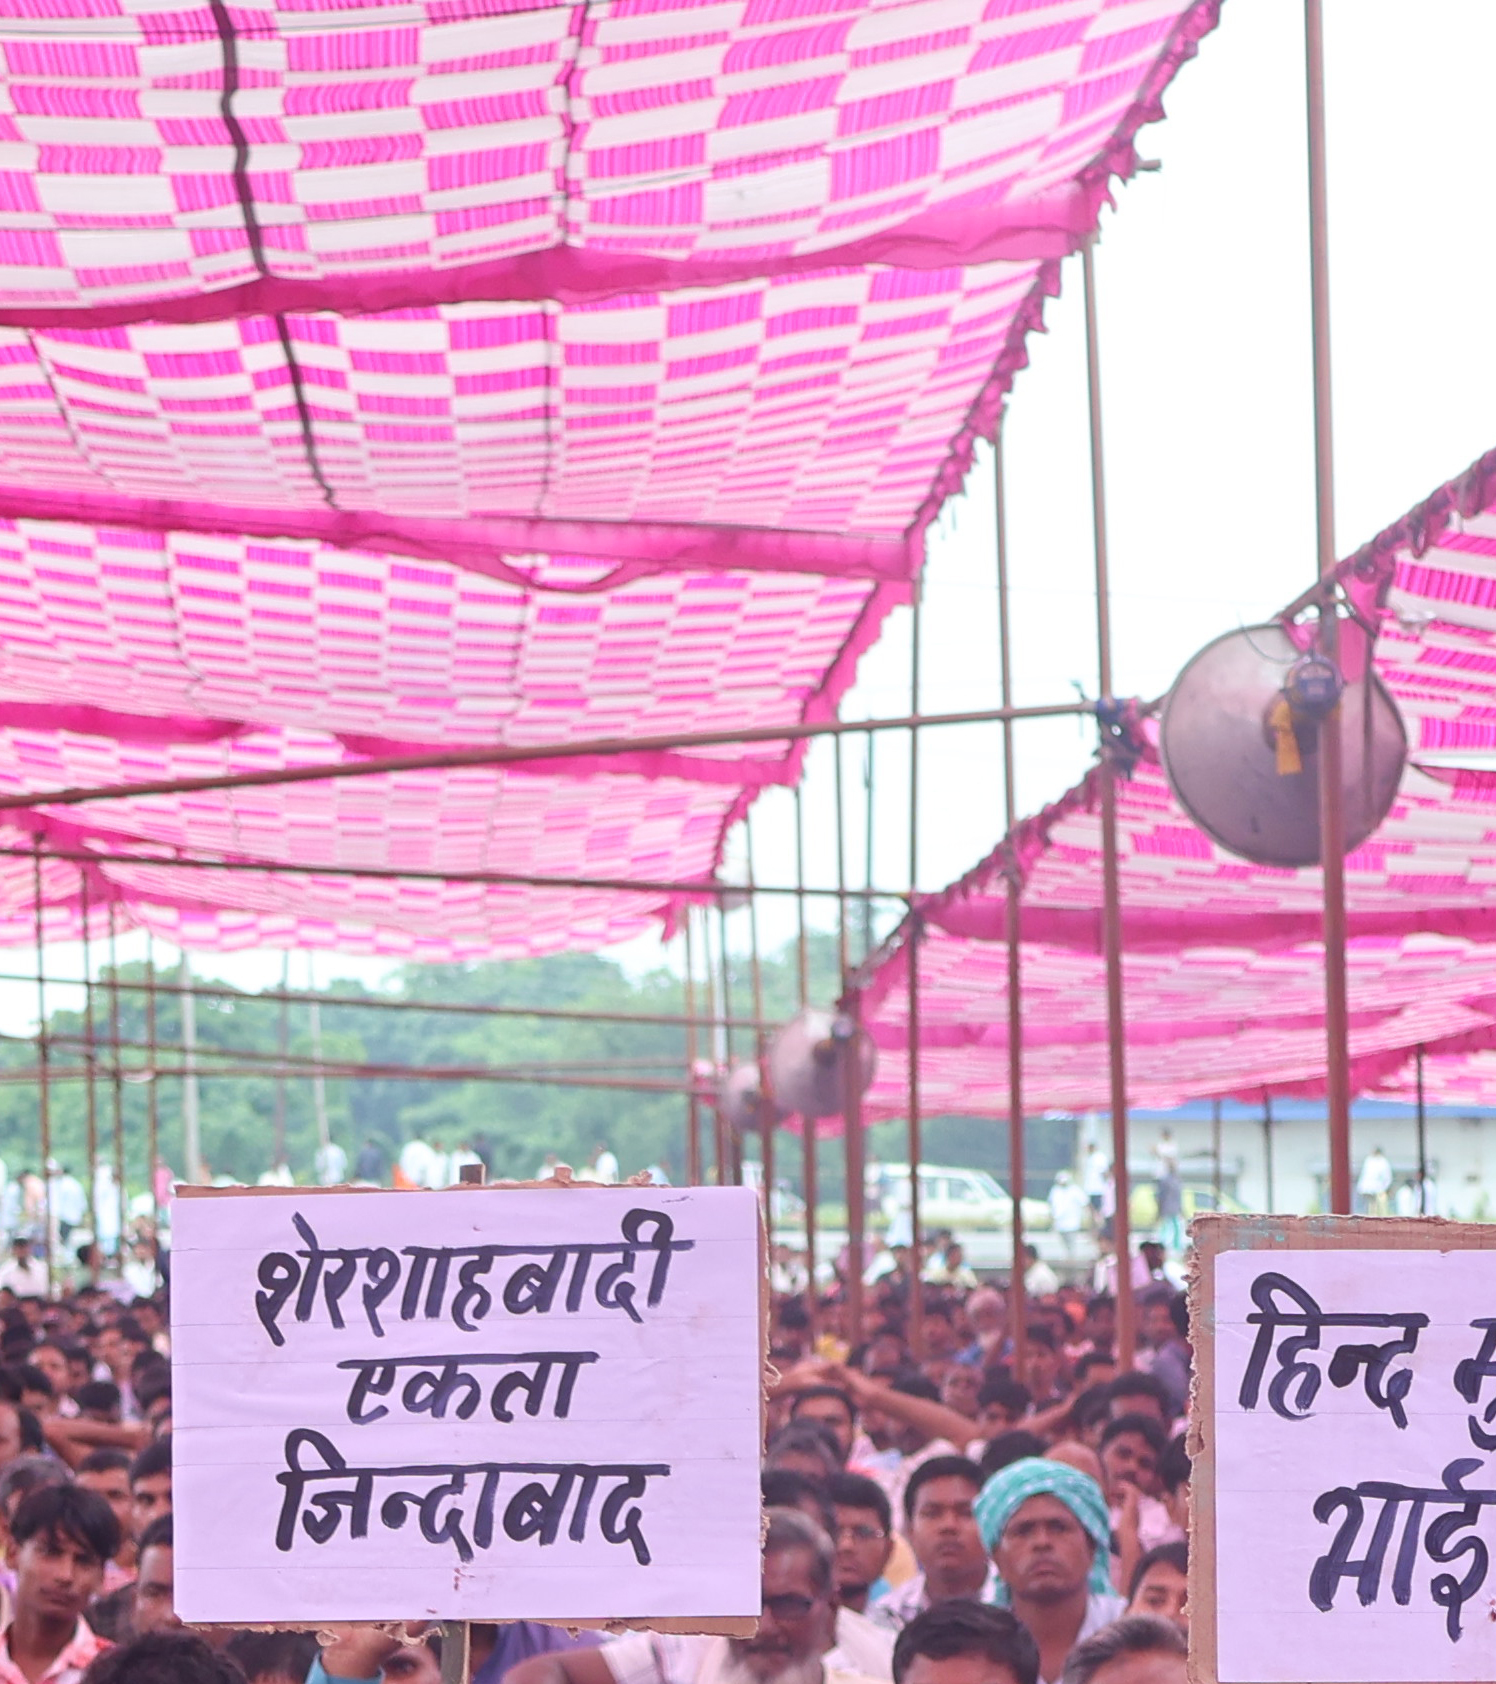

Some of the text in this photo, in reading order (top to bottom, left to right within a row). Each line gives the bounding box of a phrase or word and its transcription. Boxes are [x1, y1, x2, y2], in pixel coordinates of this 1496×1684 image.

[255, 1207, 695, 1347] शेरशाहबादी
[336, 1351, 600, 1426] एकता
[1238, 1271, 1431, 1430] हिन्द
[275, 1427, 671, 1566] जिन्दाबाद
